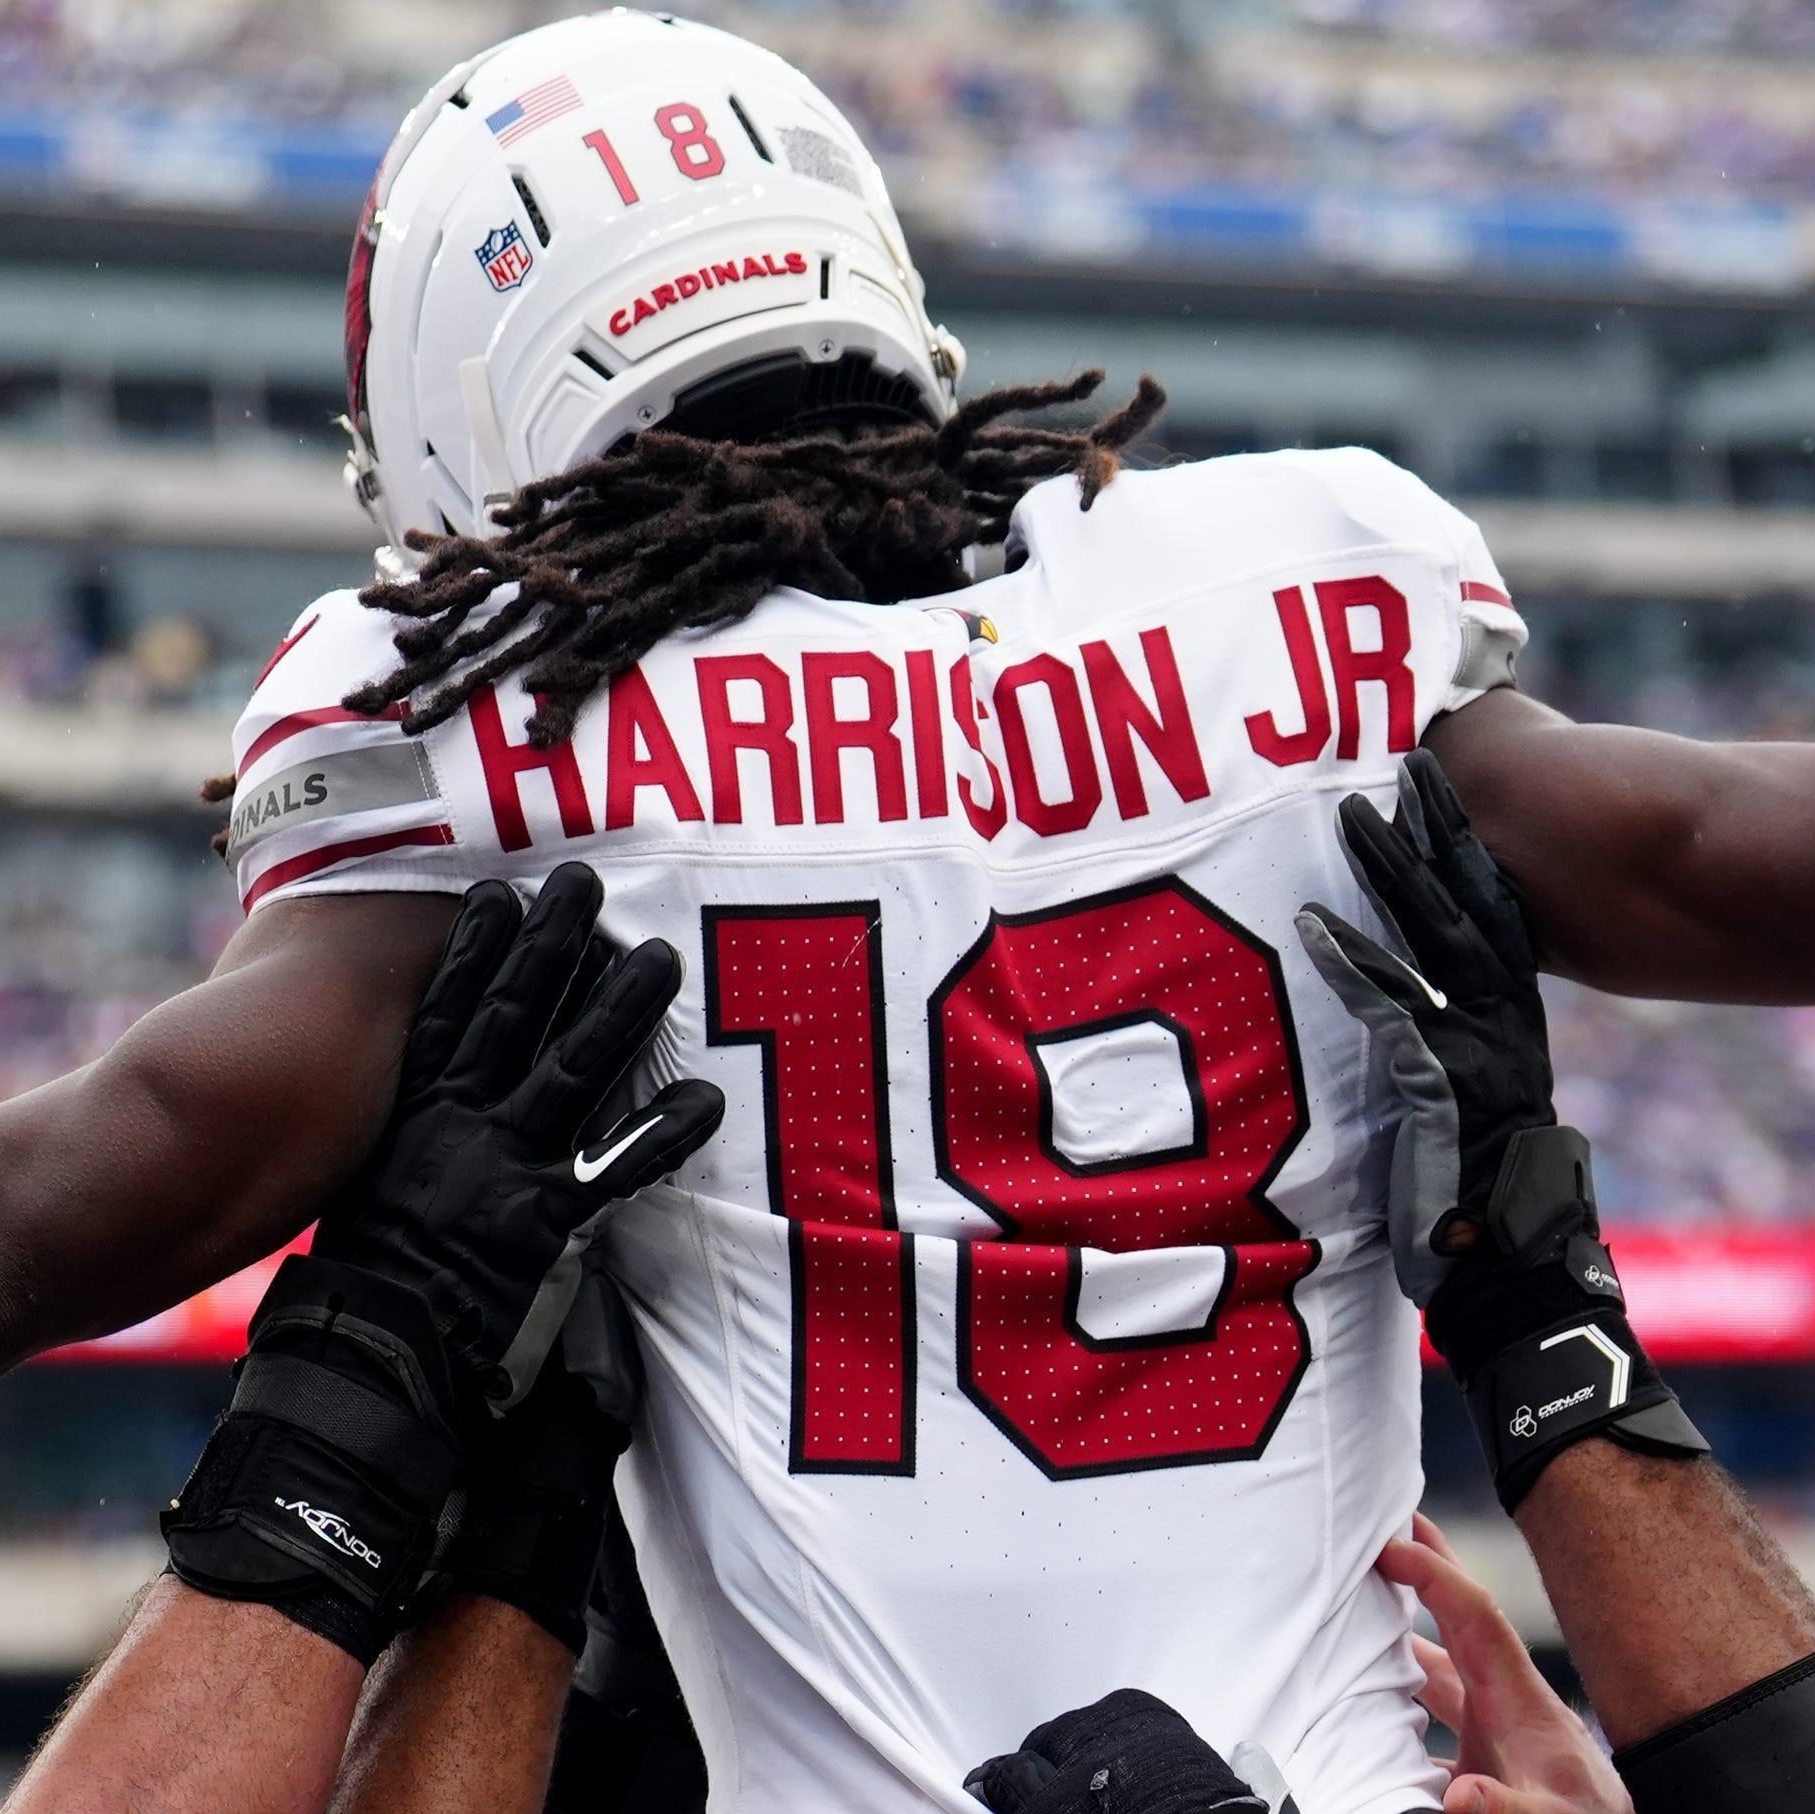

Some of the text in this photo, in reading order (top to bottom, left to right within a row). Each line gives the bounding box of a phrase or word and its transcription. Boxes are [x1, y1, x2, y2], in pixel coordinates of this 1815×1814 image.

[582, 102, 726, 206] 18
[487, 245, 531, 288] NFL
[608, 250, 808, 337] CARDINALS
[469, 574, 1417, 853] HARRISON JR
[701, 873, 1322, 1481] 18
[1538, 1384, 1596, 1418] DONJOY
